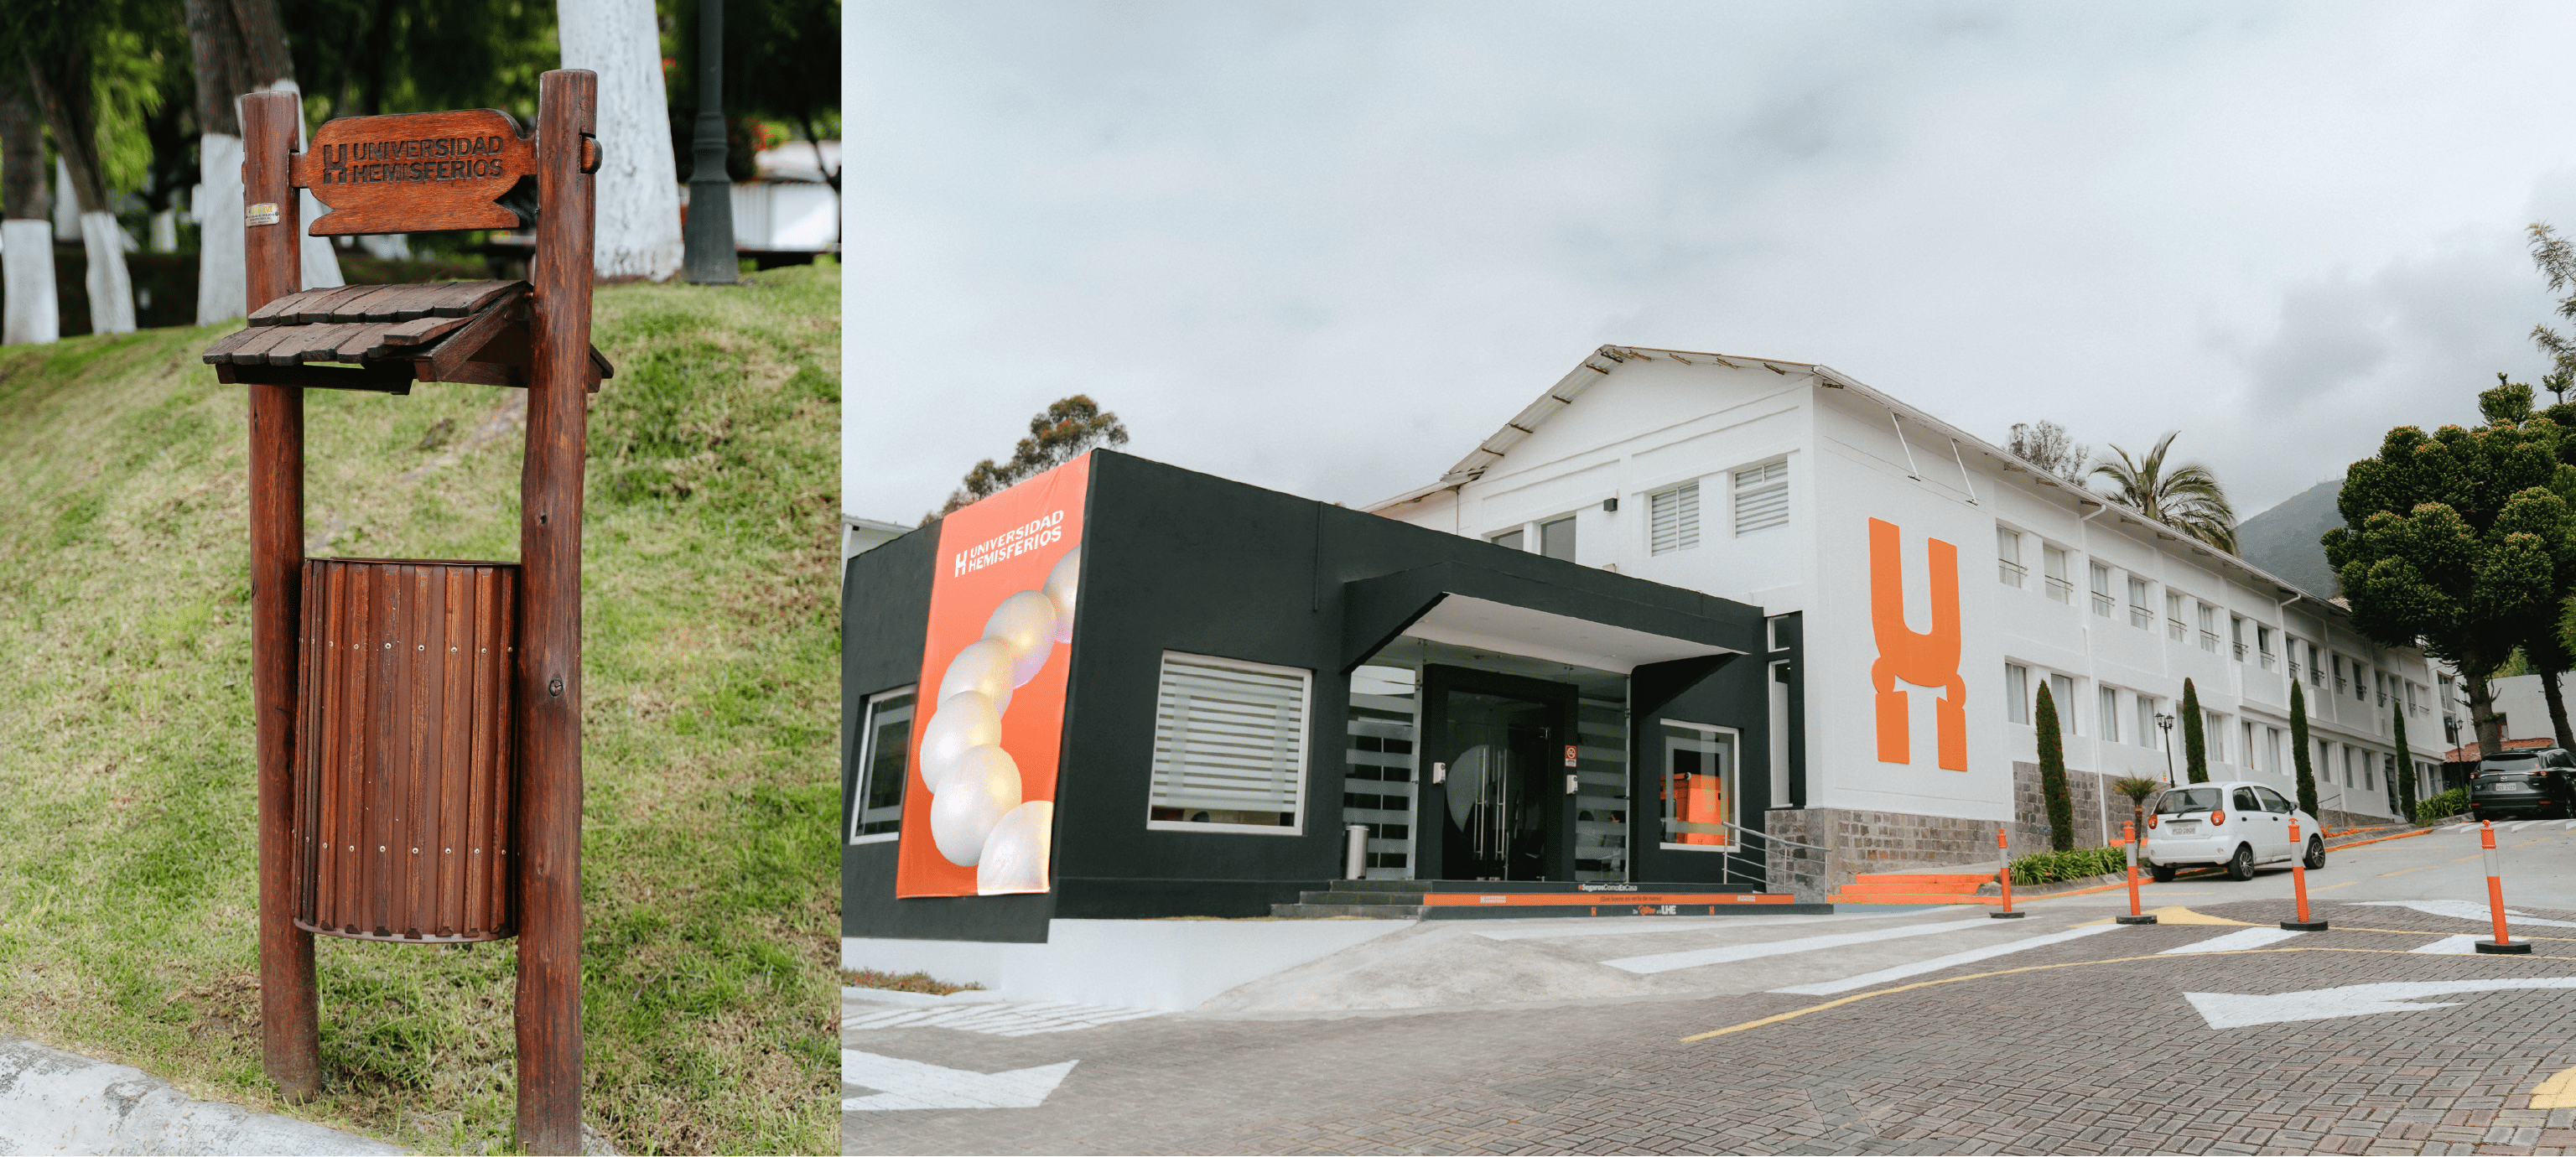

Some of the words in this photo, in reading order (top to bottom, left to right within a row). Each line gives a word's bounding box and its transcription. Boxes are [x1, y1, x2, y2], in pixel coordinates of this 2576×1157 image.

[353, 137, 503, 161] UNIVERSIDAD
[353, 159, 504, 184] HEMISFERIOS
[969, 526, 1062, 572] HEMISFERIOS
[970, 510, 1064, 558] UNIVERSIDAD
